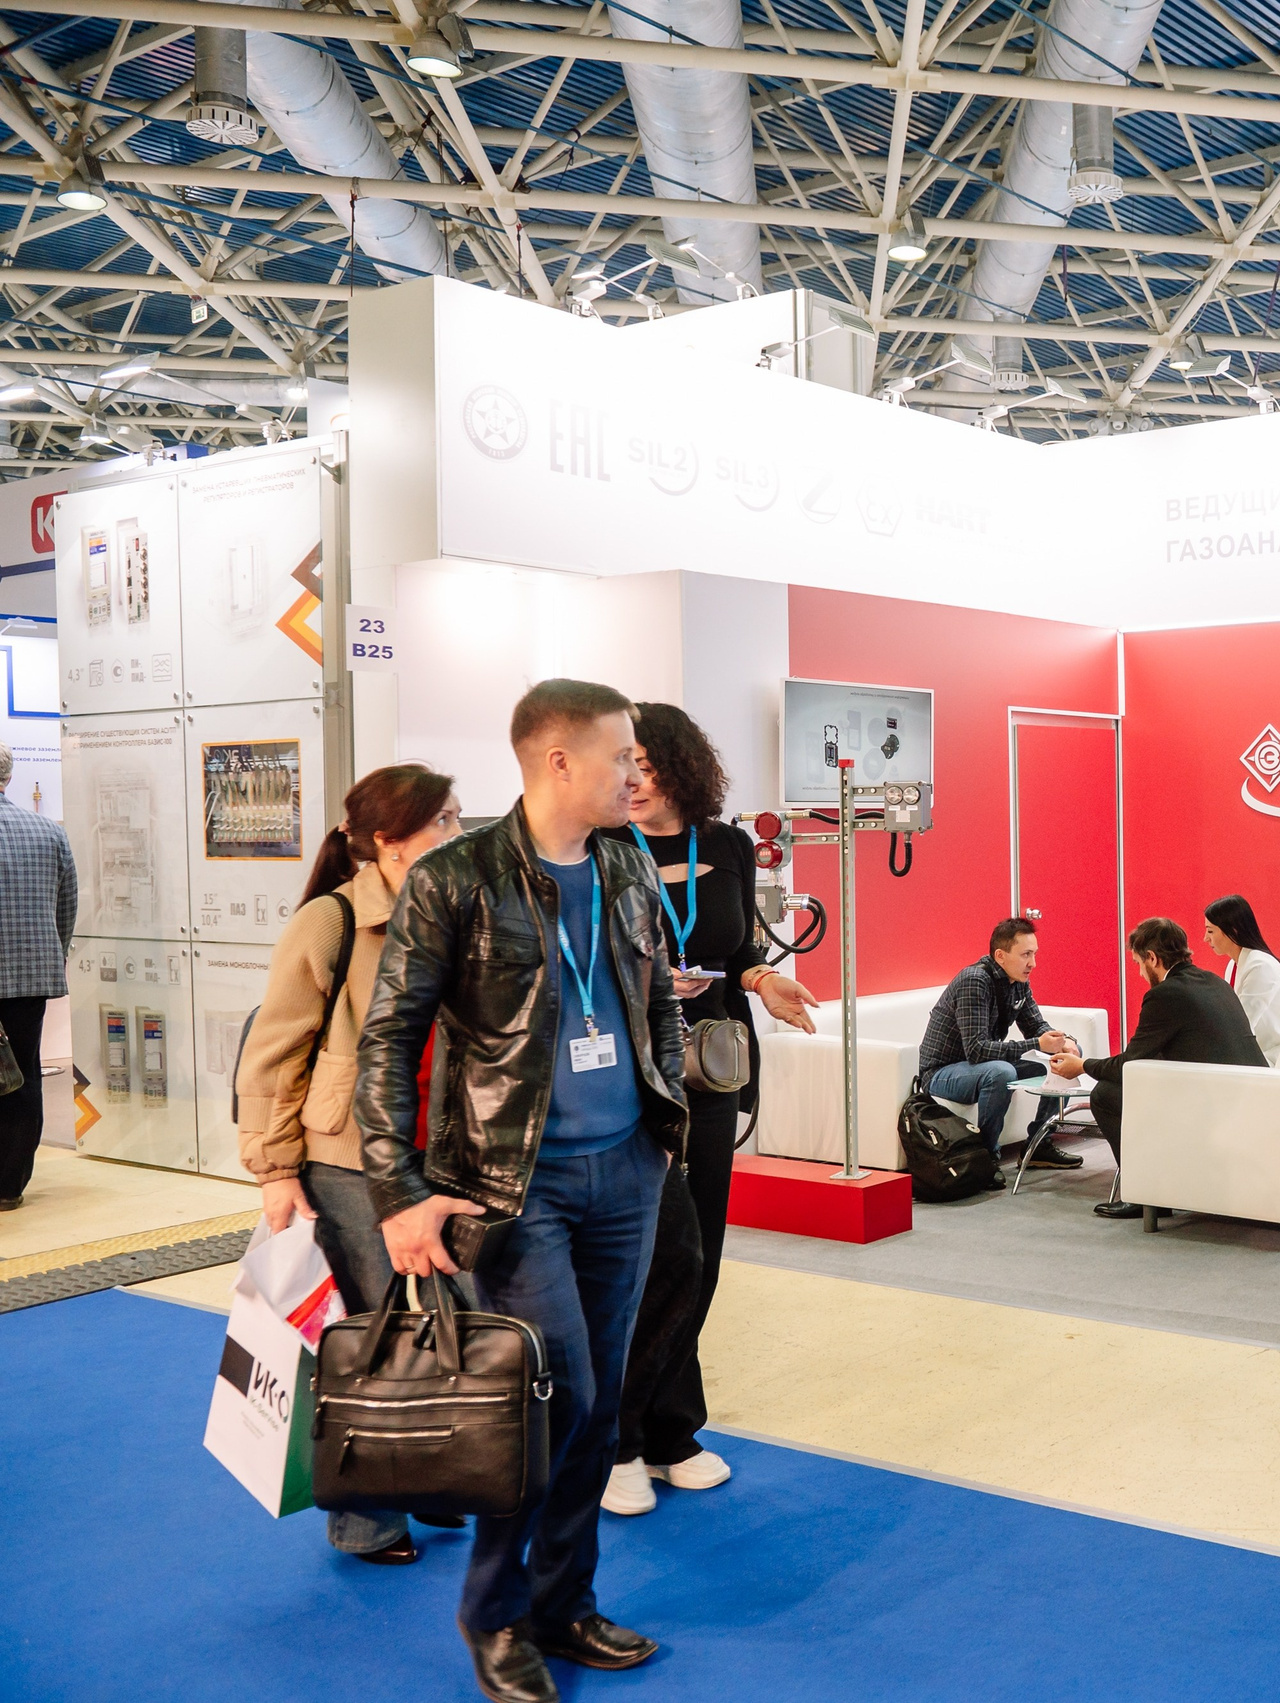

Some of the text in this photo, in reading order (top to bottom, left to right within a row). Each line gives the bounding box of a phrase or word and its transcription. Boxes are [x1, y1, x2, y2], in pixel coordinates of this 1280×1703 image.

[359, 618, 385, 633] 23
[352, 643, 393, 659] B25
[100, 729, 140, 738] СУЩЕСТВУЮЩИХ
[113, 739, 147, 747] КОНТРОЛЛЕРА
[207, 960, 228, 968] ЗАМЕНА
